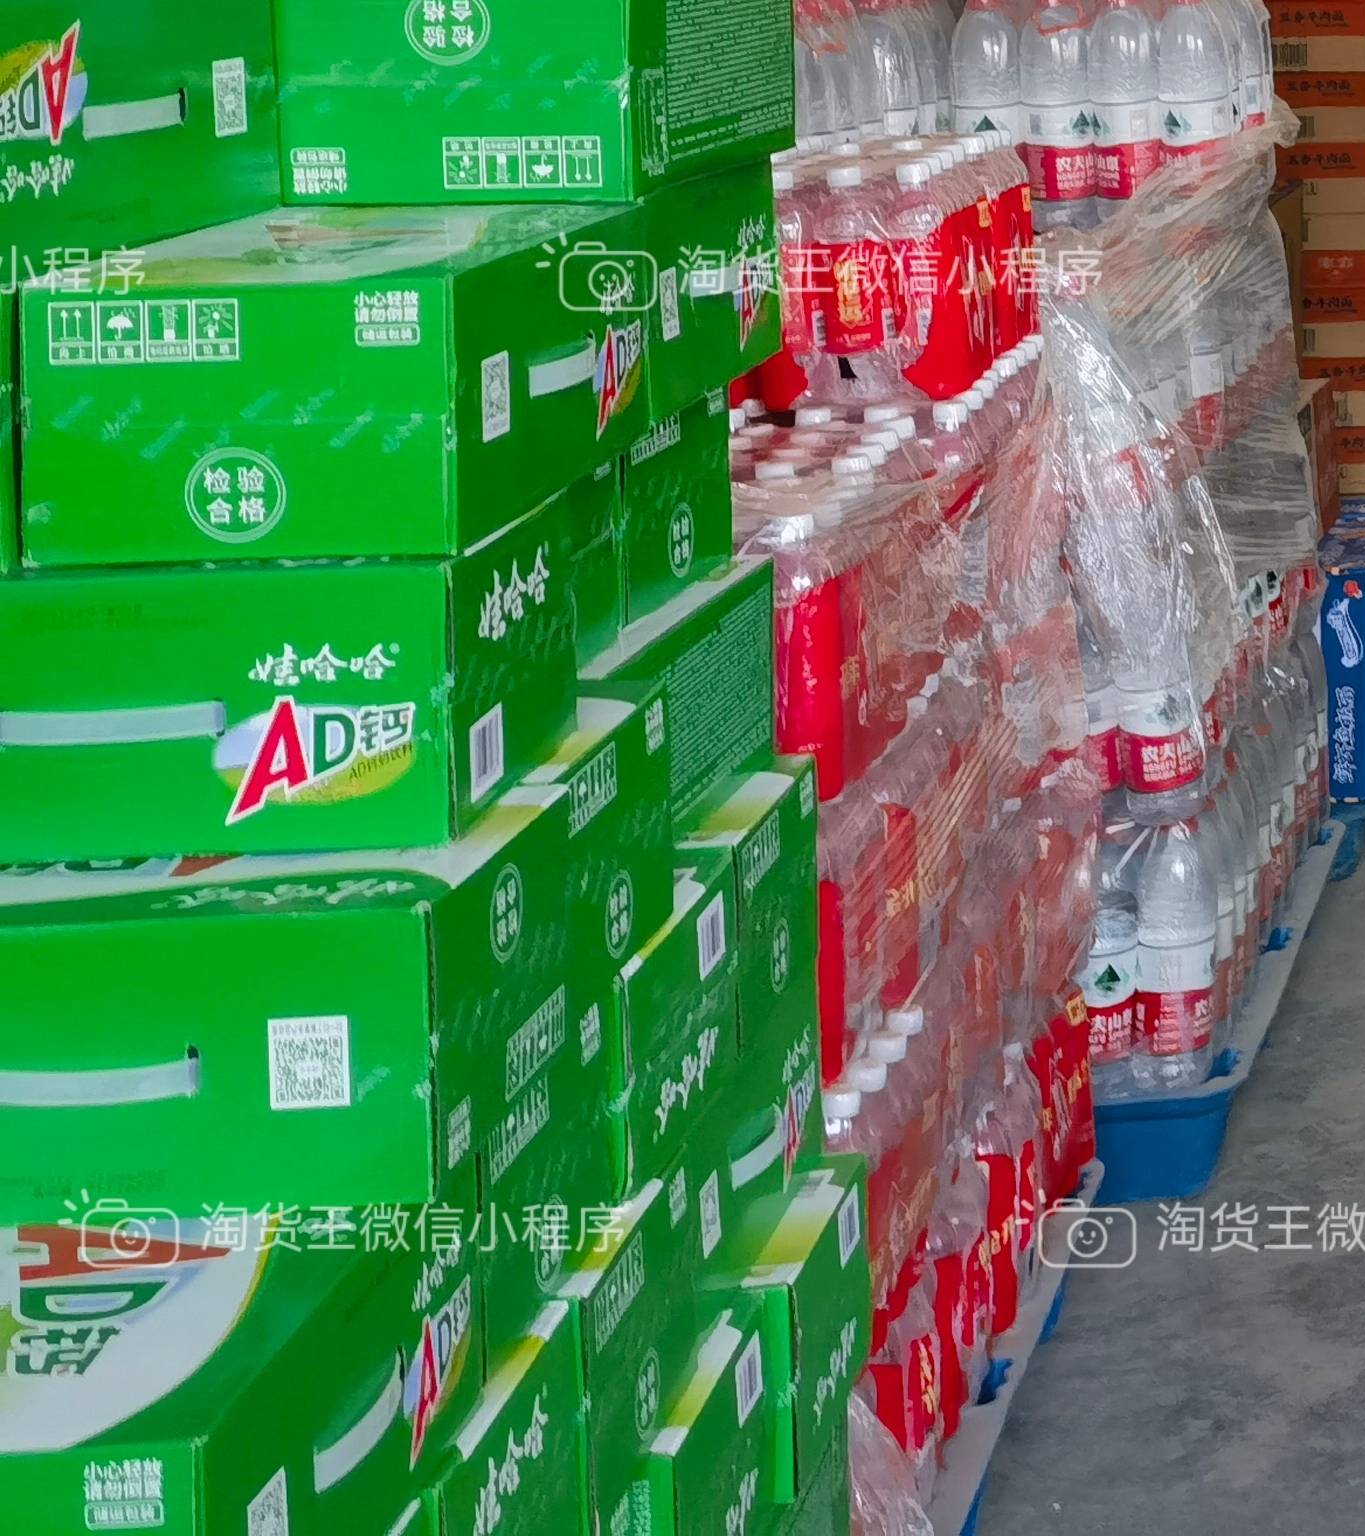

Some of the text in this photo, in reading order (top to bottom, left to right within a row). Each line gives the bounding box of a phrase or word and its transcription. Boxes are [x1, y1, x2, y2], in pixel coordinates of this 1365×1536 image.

[203, 466, 266, 495] 检验
[205, 497, 267, 524] 合格
[249, 643, 396, 684] 娃哈哈
[226, 695, 415, 825] AD钙
